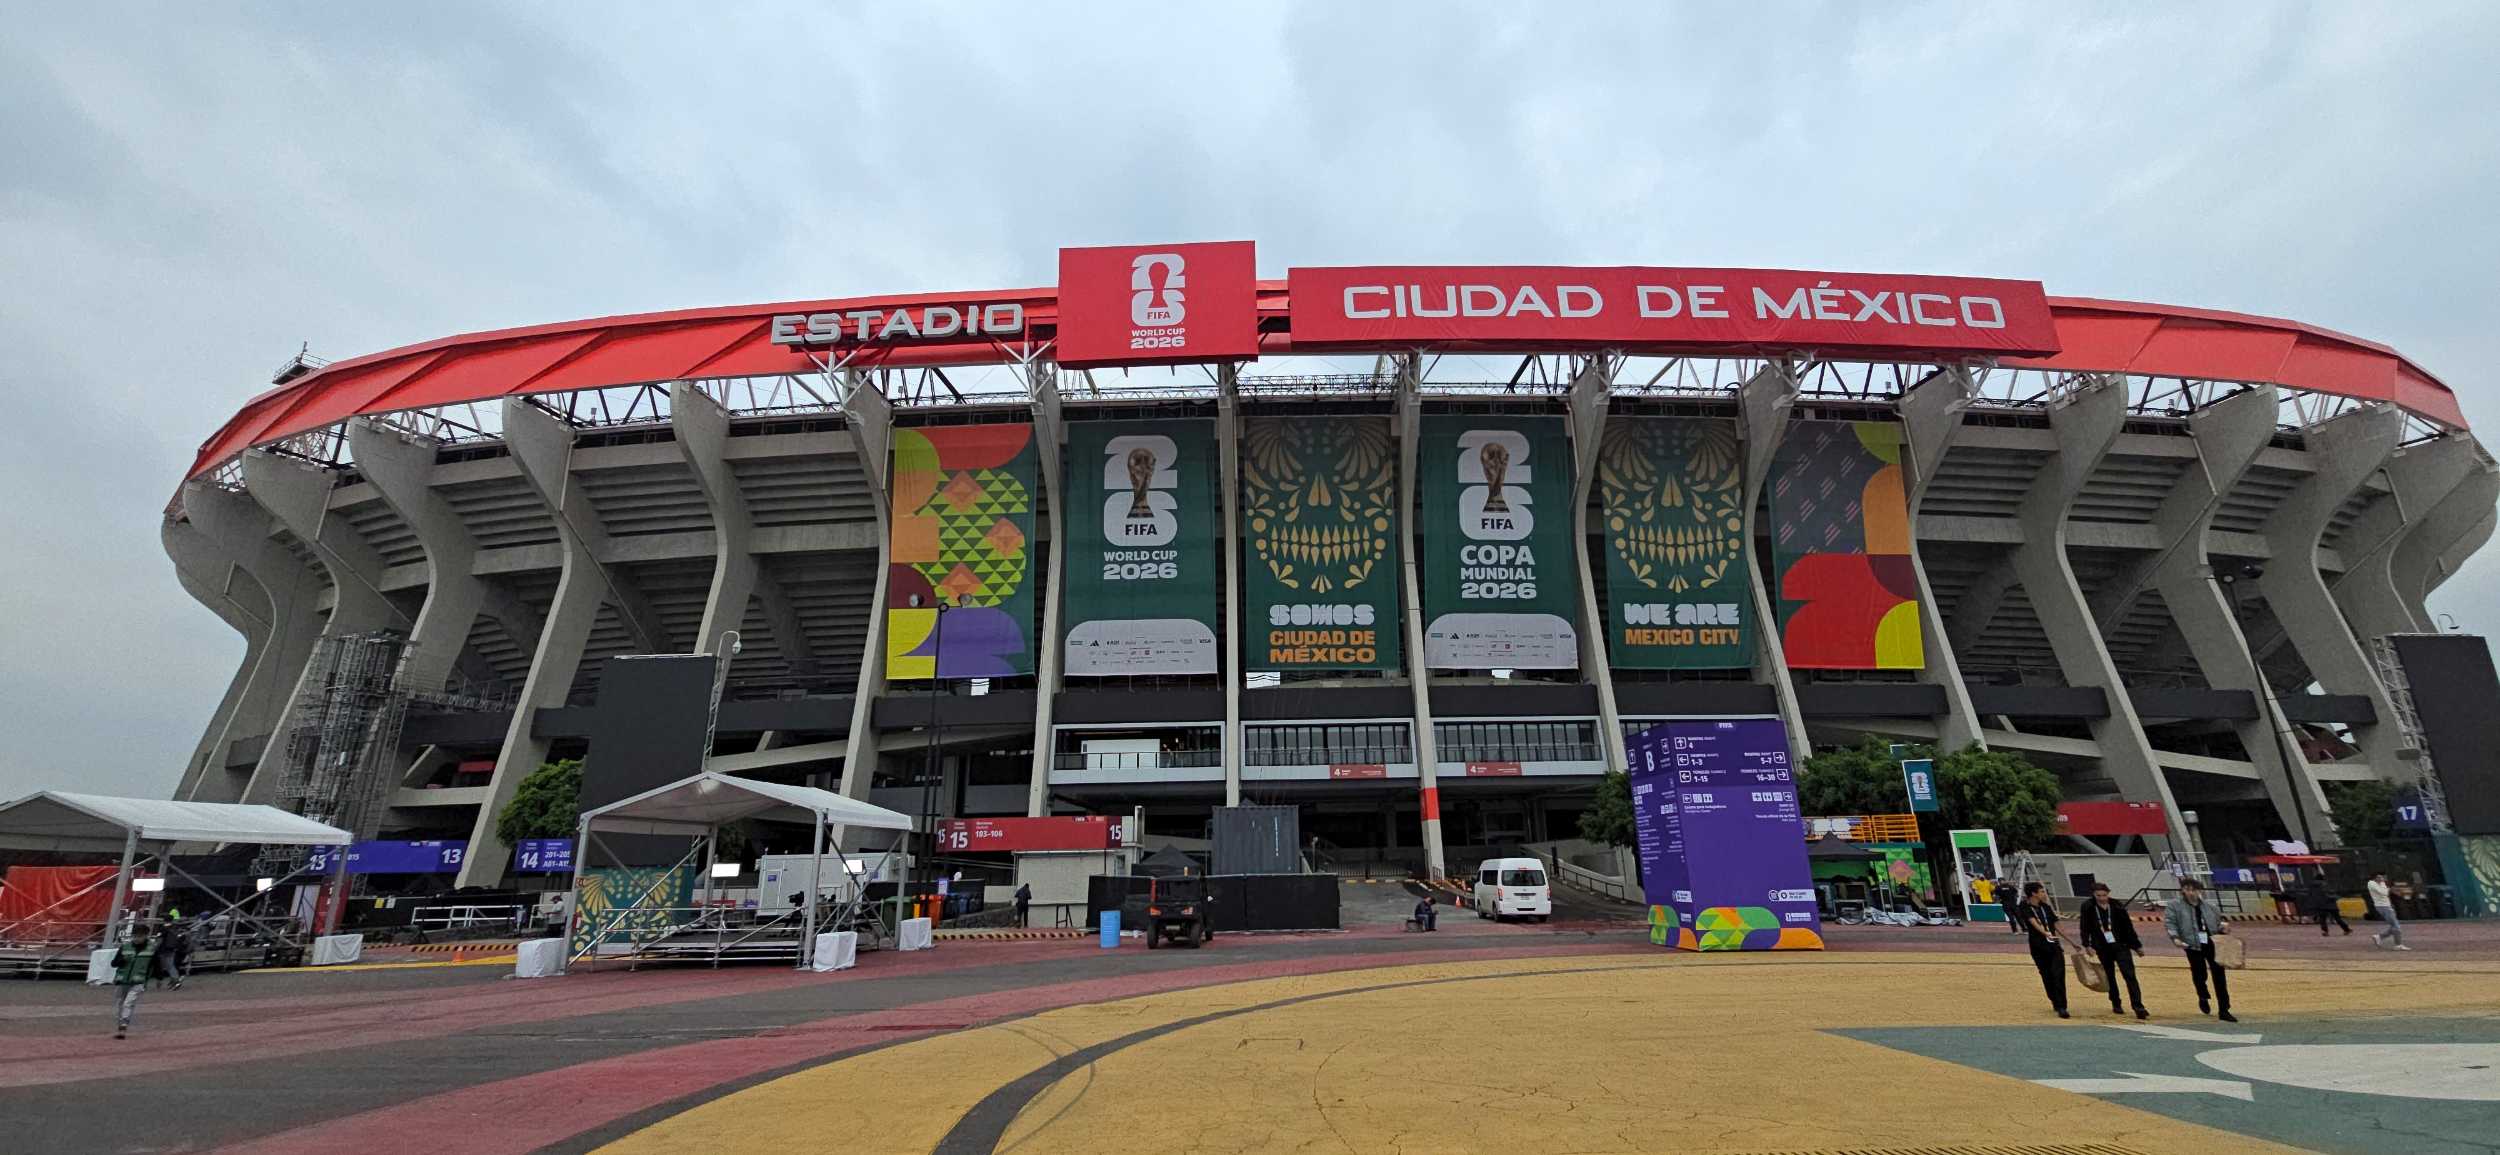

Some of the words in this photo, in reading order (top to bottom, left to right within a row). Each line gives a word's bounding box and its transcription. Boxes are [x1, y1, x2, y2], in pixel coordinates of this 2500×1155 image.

[1343, 284, 1604, 319] CIUDAD
[1639, 285, 1732, 319] DE
[1755, 281, 2006, 329] MÉXICO
[1147, 311, 1171, 320] FIFA
[770, 303, 1024, 345] ESTADIO
[1131, 328, 1165, 337] WORLD
[1166, 327, 1185, 336] CUP
[1130, 336, 1186, 349] 2026
[1125, 524, 1158, 537] FIFA
[1481, 518, 1514, 531] FIFA
[1103, 550, 1150, 562] WORLD
[1151, 550, 1178, 561] CUP
[1460, 545, 1536, 566] COPA
[1103, 562, 1178, 580] 2026
[1460, 567, 1536, 581] MUNDIAL
[1461, 582, 1537, 600] 2026
[1269, 604, 1375, 626] SOMOS
[1623, 603, 1671, 625] WE
[1675, 603, 1739, 625] ARE
[1269, 630, 1345, 645] CIUDAD
[1353, 630, 1375, 645] DE
[1625, 629, 1694, 646] MEXICO
[1699, 629, 1740, 646] CITY
[1269, 644, 1376, 664] MÉXICO
[1645, 751, 1655, 772] B
[1334, 768, 1341, 777] 4
[2397, 805, 2417, 821] 17
[950, 831, 968, 849] 15
[1109, 824, 1122, 840] 15
[442, 848, 462, 864] 13
[521, 852, 539, 868] 14
